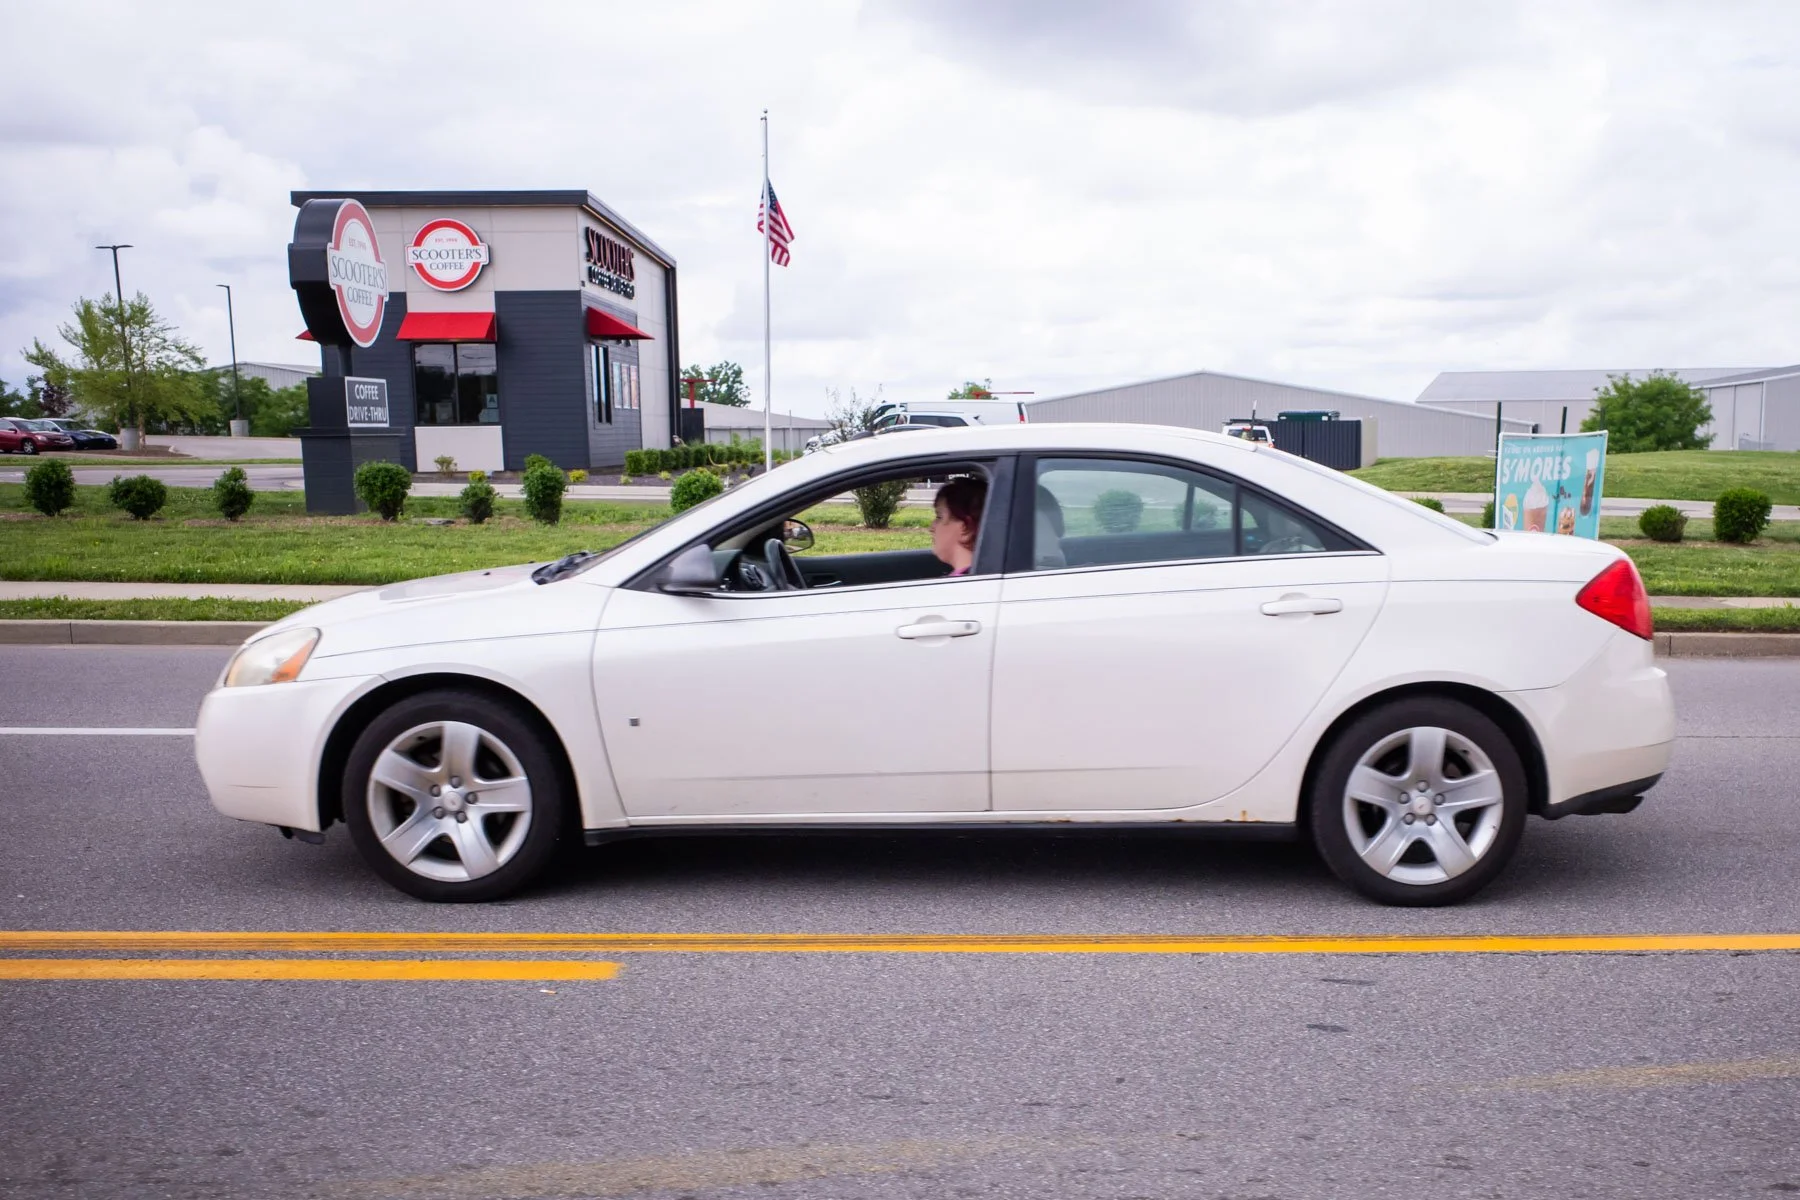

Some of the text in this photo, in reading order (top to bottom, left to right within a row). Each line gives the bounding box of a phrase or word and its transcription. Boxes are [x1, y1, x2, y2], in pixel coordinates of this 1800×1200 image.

[412, 248, 482, 260] SCOOTER'S
[585, 227, 634, 281] SCOOTER'S
[332, 256, 384, 289] SCOOTER'S
[430, 261, 465, 270] COFFEE
[347, 287, 373, 305] COFFEE
[354, 384, 379, 399] COFFEE
[349, 406, 387, 421] DRIVE-THRU
[1502, 456, 1572, 484] S'MORES
